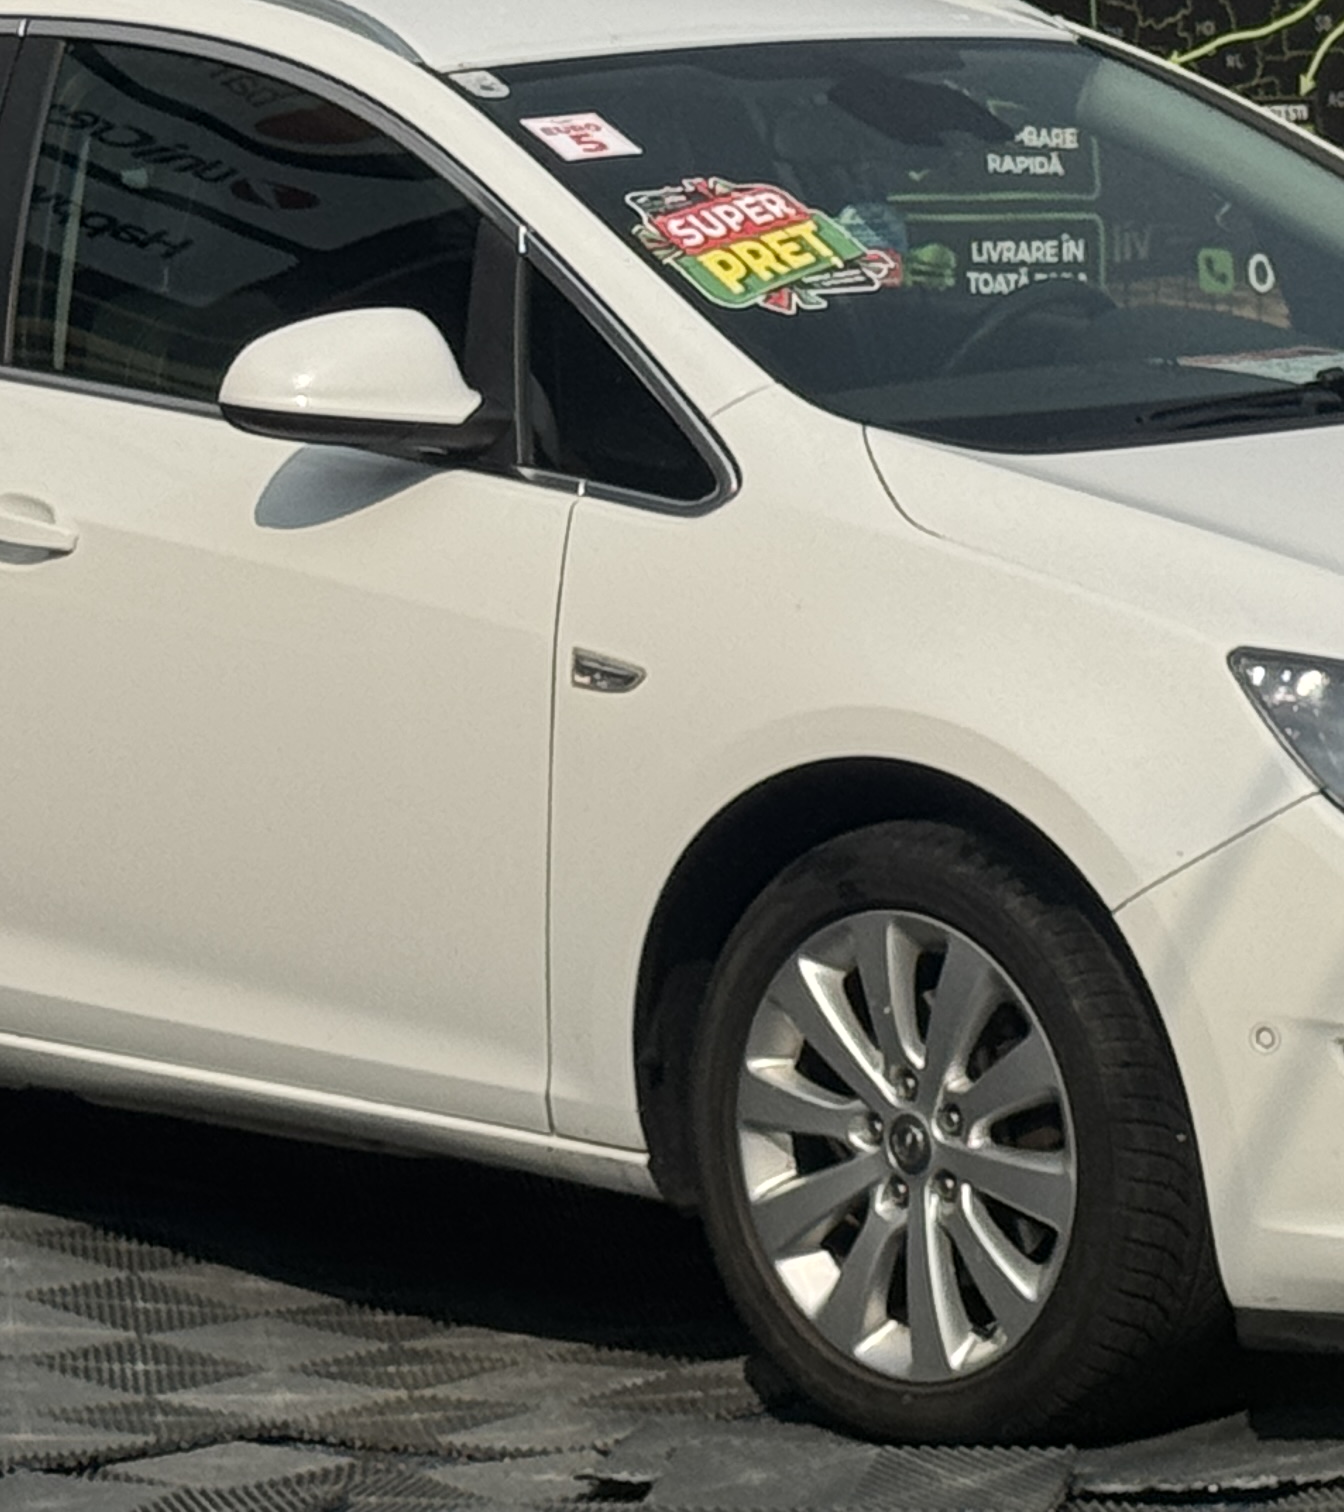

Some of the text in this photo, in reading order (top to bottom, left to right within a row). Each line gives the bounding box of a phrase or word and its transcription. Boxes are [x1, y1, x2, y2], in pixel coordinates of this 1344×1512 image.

[568, 133, 610, 154] 5
[986, 151, 1066, 177] RAPIDĂ
[666, 191, 800, 248] SUPER
[970, 240, 1059, 264] LIVRARE
[1060, 232, 1085, 263] ÎN
